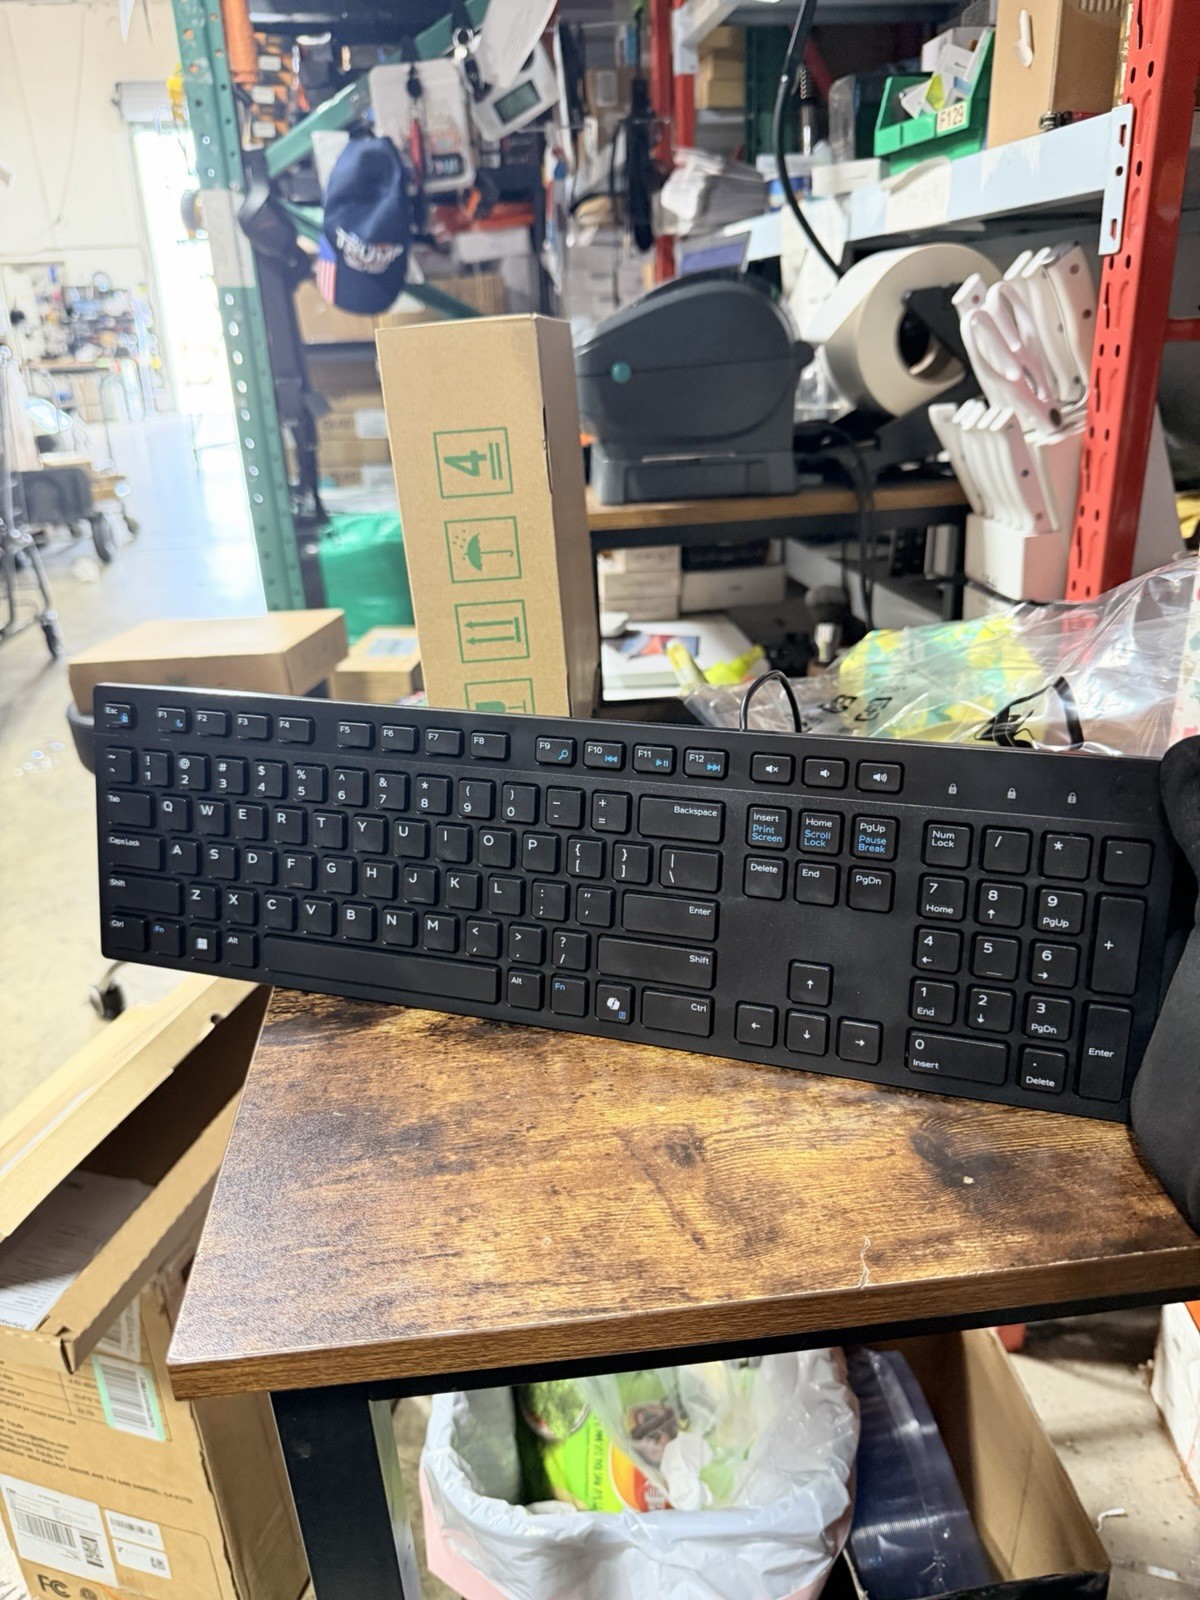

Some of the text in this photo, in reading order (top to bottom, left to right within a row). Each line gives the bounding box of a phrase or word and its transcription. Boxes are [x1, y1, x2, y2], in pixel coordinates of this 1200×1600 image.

[105, 706, 118, 715] Esc
[158, 711, 167, 719] F1
[197, 714, 208, 722] F2
[238, 717, 248, 725] F3
[279, 721, 290, 729] F4
[428, 733, 438, 741] F7
[473, 737, 485, 745] F8
[539, 742, 550, 750] F9
[587, 746, 602, 754] F10
[638, 750, 651, 758] F11
[689, 754, 705, 763] F12
[179, 758, 191, 769] @
[218, 763, 228, 773] #
[258, 765, 266, 776] $
[296, 769, 307, 780] %
[180, 775, 189, 785] 2
[219, 779, 227, 788] 3
[379, 778, 388, 788] &
[257, 782, 266, 792] 4
[298, 786, 305, 796] 5
[108, 795, 121, 803] Tab
[338, 790, 346, 800] 6
[379, 795, 387, 803] 7
[163, 802, 173, 812] Q
[421, 799, 429, 808] 8
[463, 803, 471, 813] 9
[599, 799, 607, 807] +
[201, 805, 214, 816] W
[239, 809, 247, 820] E
[507, 807, 515, 816] 0
[674, 806, 718, 817] Backspace
[277, 813, 287, 824] R
[317, 817, 326, 828] T
[753, 813, 779, 823] Insert
[805, 818, 833, 827] Home
[357, 822, 367, 832] Y
[399, 826, 408, 837] U
[752, 824, 774, 834] Print
[860, 822, 886, 834] PgUp
[752, 832, 782, 843] Screen
[804, 829, 831, 839] Scroll
[932, 830, 955, 840] Num
[483, 836, 494, 846] O
[528, 840, 538, 850] P
[804, 838, 826, 847] Lock
[859, 835, 887, 845] Pause
[931, 839, 955, 848] Lock
[995, 836, 1002, 847] /
[172, 845, 182, 855] A
[575, 843, 580, 856] {
[858, 843, 886, 853] Break
[210, 849, 219, 860] S
[248, 853, 258, 864] D
[622, 849, 628, 861] }
[287, 858, 295, 869] F
[327, 863, 336, 873] G
[750, 863, 778, 873] Delete
[366, 867, 377, 878] H
[802, 869, 820, 878] End
[110, 878, 125, 887] Shift
[409, 873, 417, 883] J
[450, 877, 460, 888] K
[856, 875, 882, 886] PgDn
[494, 883, 502, 894] L
[929, 883, 938, 894] 7
[191, 890, 200, 900] Z
[229, 894, 238, 905] X
[988, 890, 998, 901] 8
[267, 899, 276, 910] C
[1047, 896, 1058, 907] 9
[306, 905, 316, 915] V
[689, 906, 712, 916] Enter
[926, 904, 954, 914] Home
[347, 910, 355, 920] B
[111, 919, 125, 927] Ctrl
[387, 915, 397, 926] N
[427, 920, 439, 931] M
[1043, 917, 1069, 929] PgUp
[154, 925, 165, 933] Fn
[472, 927, 479, 935] <
[227, 937, 239, 945] Alt
[515, 933, 522, 941] >
[923, 935, 933, 946] 4
[560, 937, 567, 948] ?
[1104, 940, 1114, 950] +
[983, 943, 993, 953] 5
[560, 954, 566, 964] /
[689, 954, 709, 965] Shift
[1042, 950, 1052, 961] 6
[510, 976, 523, 985] Alt
[555, 983, 565, 991] Fn
[920, 987, 927, 997] 1
[978, 995, 987, 1005] 2
[690, 1003, 707, 1013] Ctrl
[917, 1007, 934, 1017] End
[1036, 1003, 1046, 1014] 3
[1031, 1023, 1057, 1034] PgDn
[1088, 1048, 1114, 1058] Enter
[913, 1059, 940, 1070] Insert
[1026, 1076, 1055, 1087] Delete
